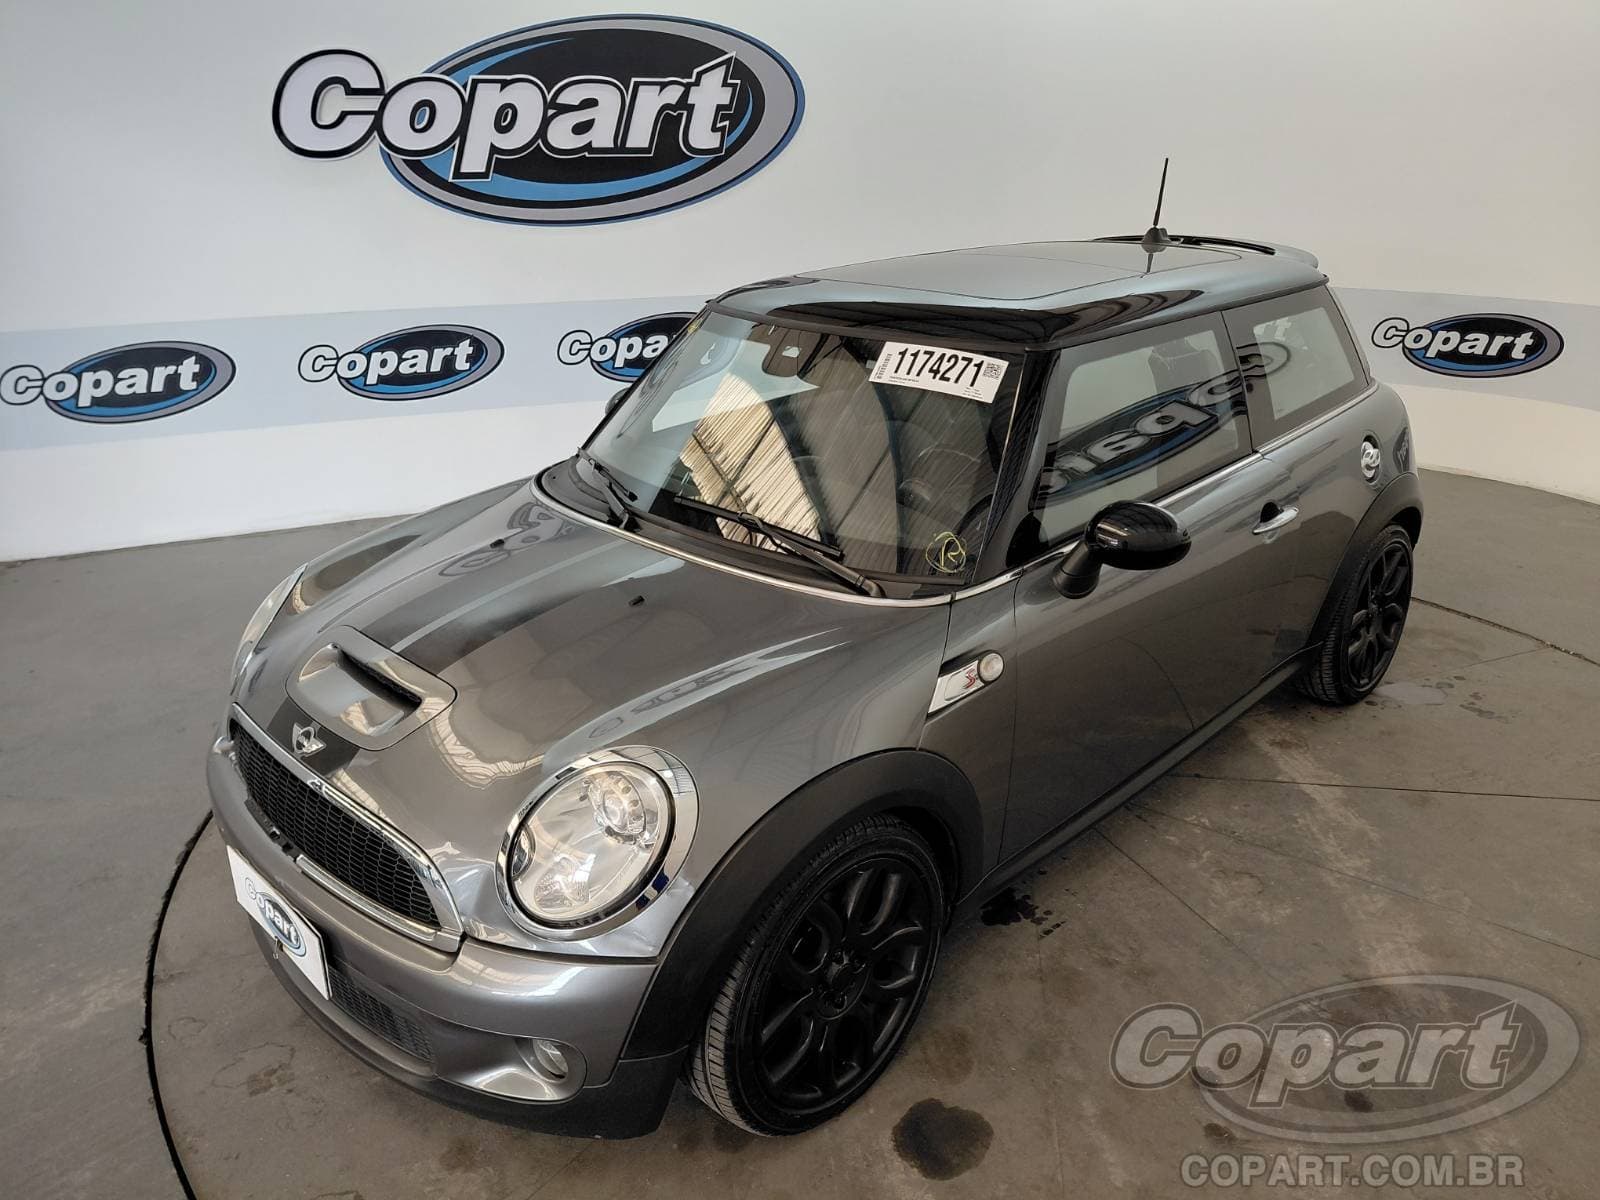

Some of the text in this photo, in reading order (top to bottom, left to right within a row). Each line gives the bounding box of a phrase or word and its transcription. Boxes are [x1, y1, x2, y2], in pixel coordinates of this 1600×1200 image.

[272, 49, 738, 181] Copart
[298, 337, 474, 386] Copart
[557, 330, 678, 369] Copa
[1371, 317, 1535, 360] Copart
[0, 356, 200, 408] Copart
[893, 347, 985, 387] 1174271
[245, 877, 300, 945] Copart
